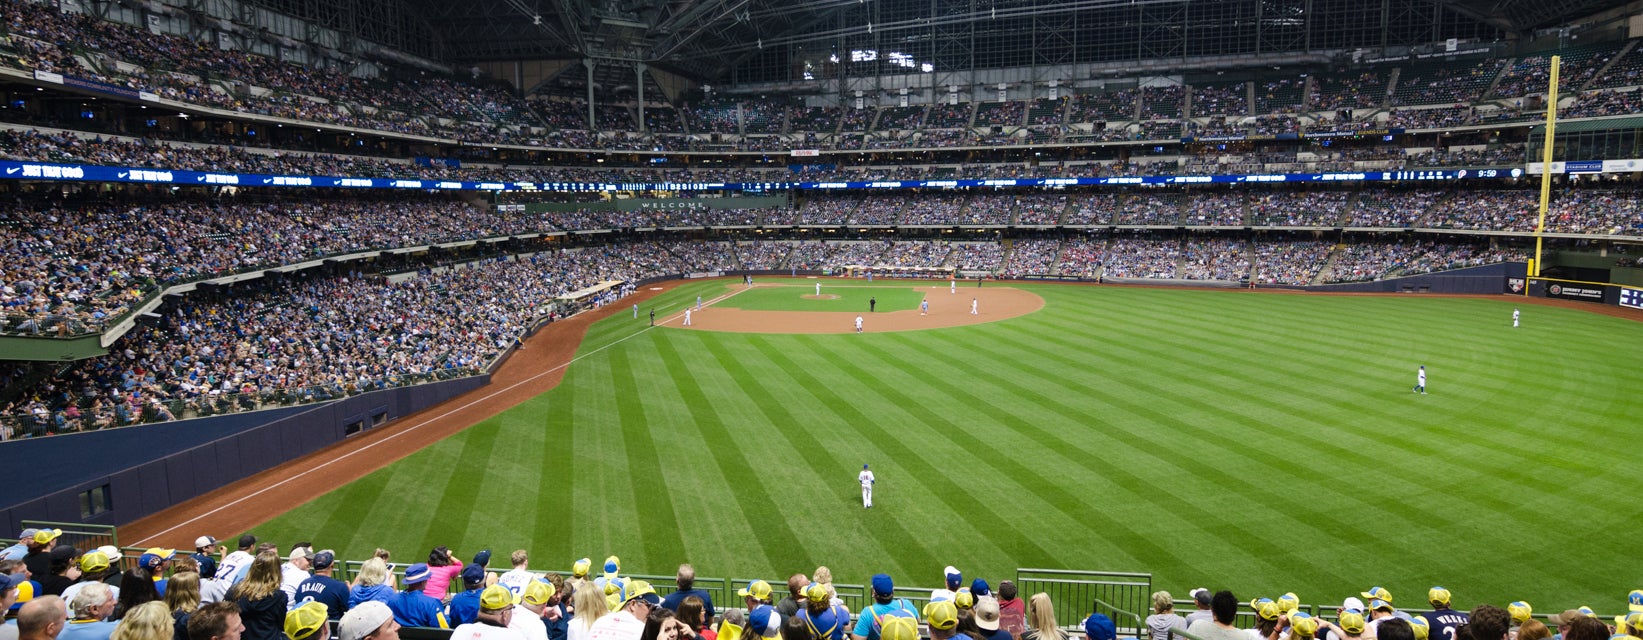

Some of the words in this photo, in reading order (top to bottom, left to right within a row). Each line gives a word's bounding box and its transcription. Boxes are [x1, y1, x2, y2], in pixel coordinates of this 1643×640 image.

[87, 83, 114, 92] COMMUNITY
[114, 88, 140, 97] FOUNDATION
[22, 165, 42, 177] JUST
[61, 167, 84, 179] GOOD
[214, 563, 236, 580] 27
[301, 583, 326, 594] BRAUN
